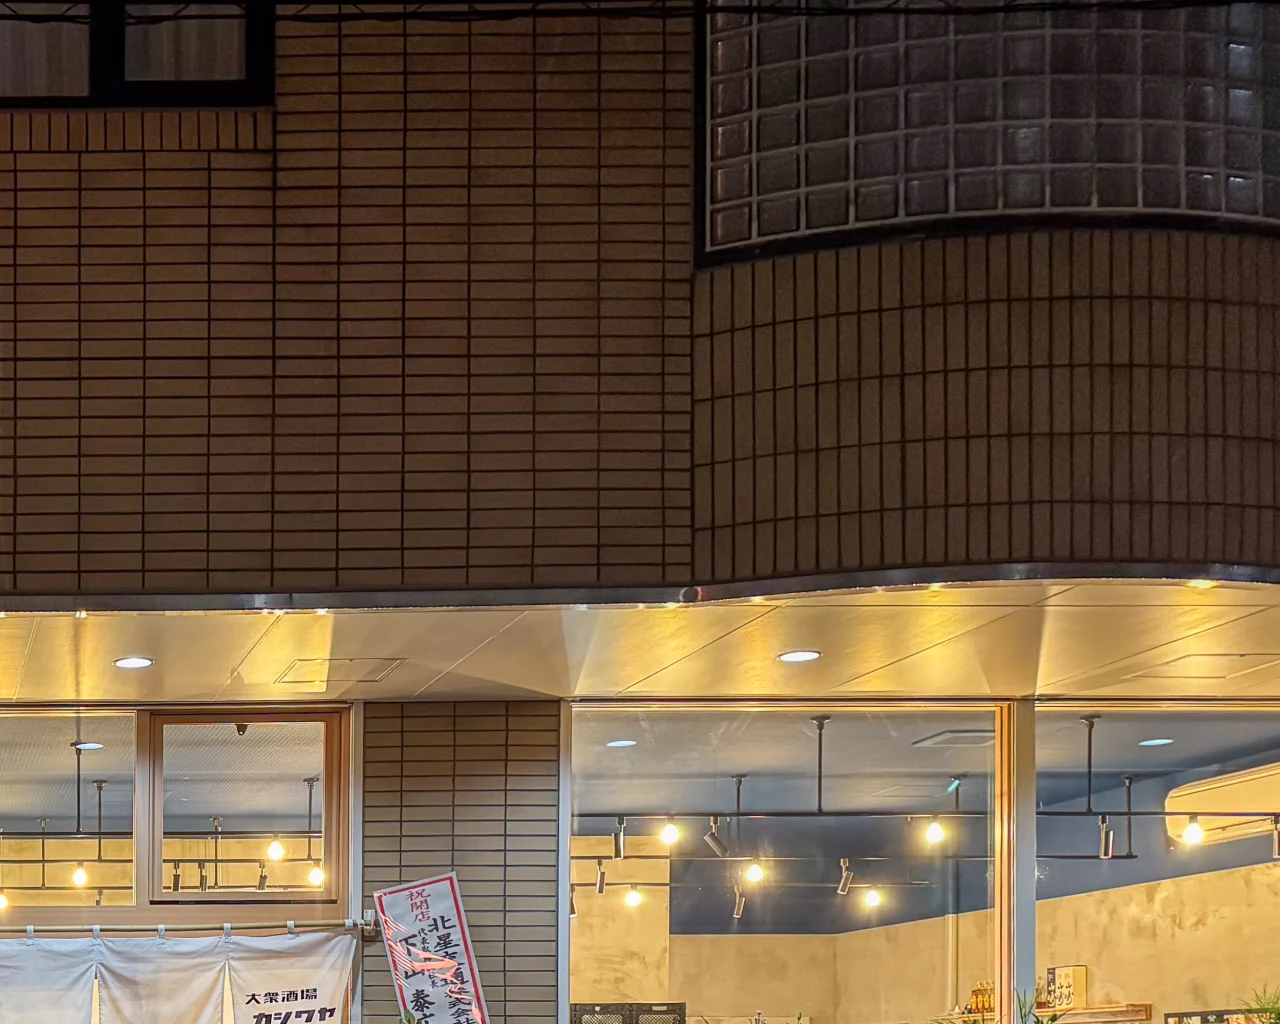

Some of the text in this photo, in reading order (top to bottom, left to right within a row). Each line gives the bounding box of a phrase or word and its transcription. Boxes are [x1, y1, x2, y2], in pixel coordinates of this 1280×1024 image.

[405, 889, 431, 924] 祝開店
[245, 988, 317, 1004] 大衆酒場
